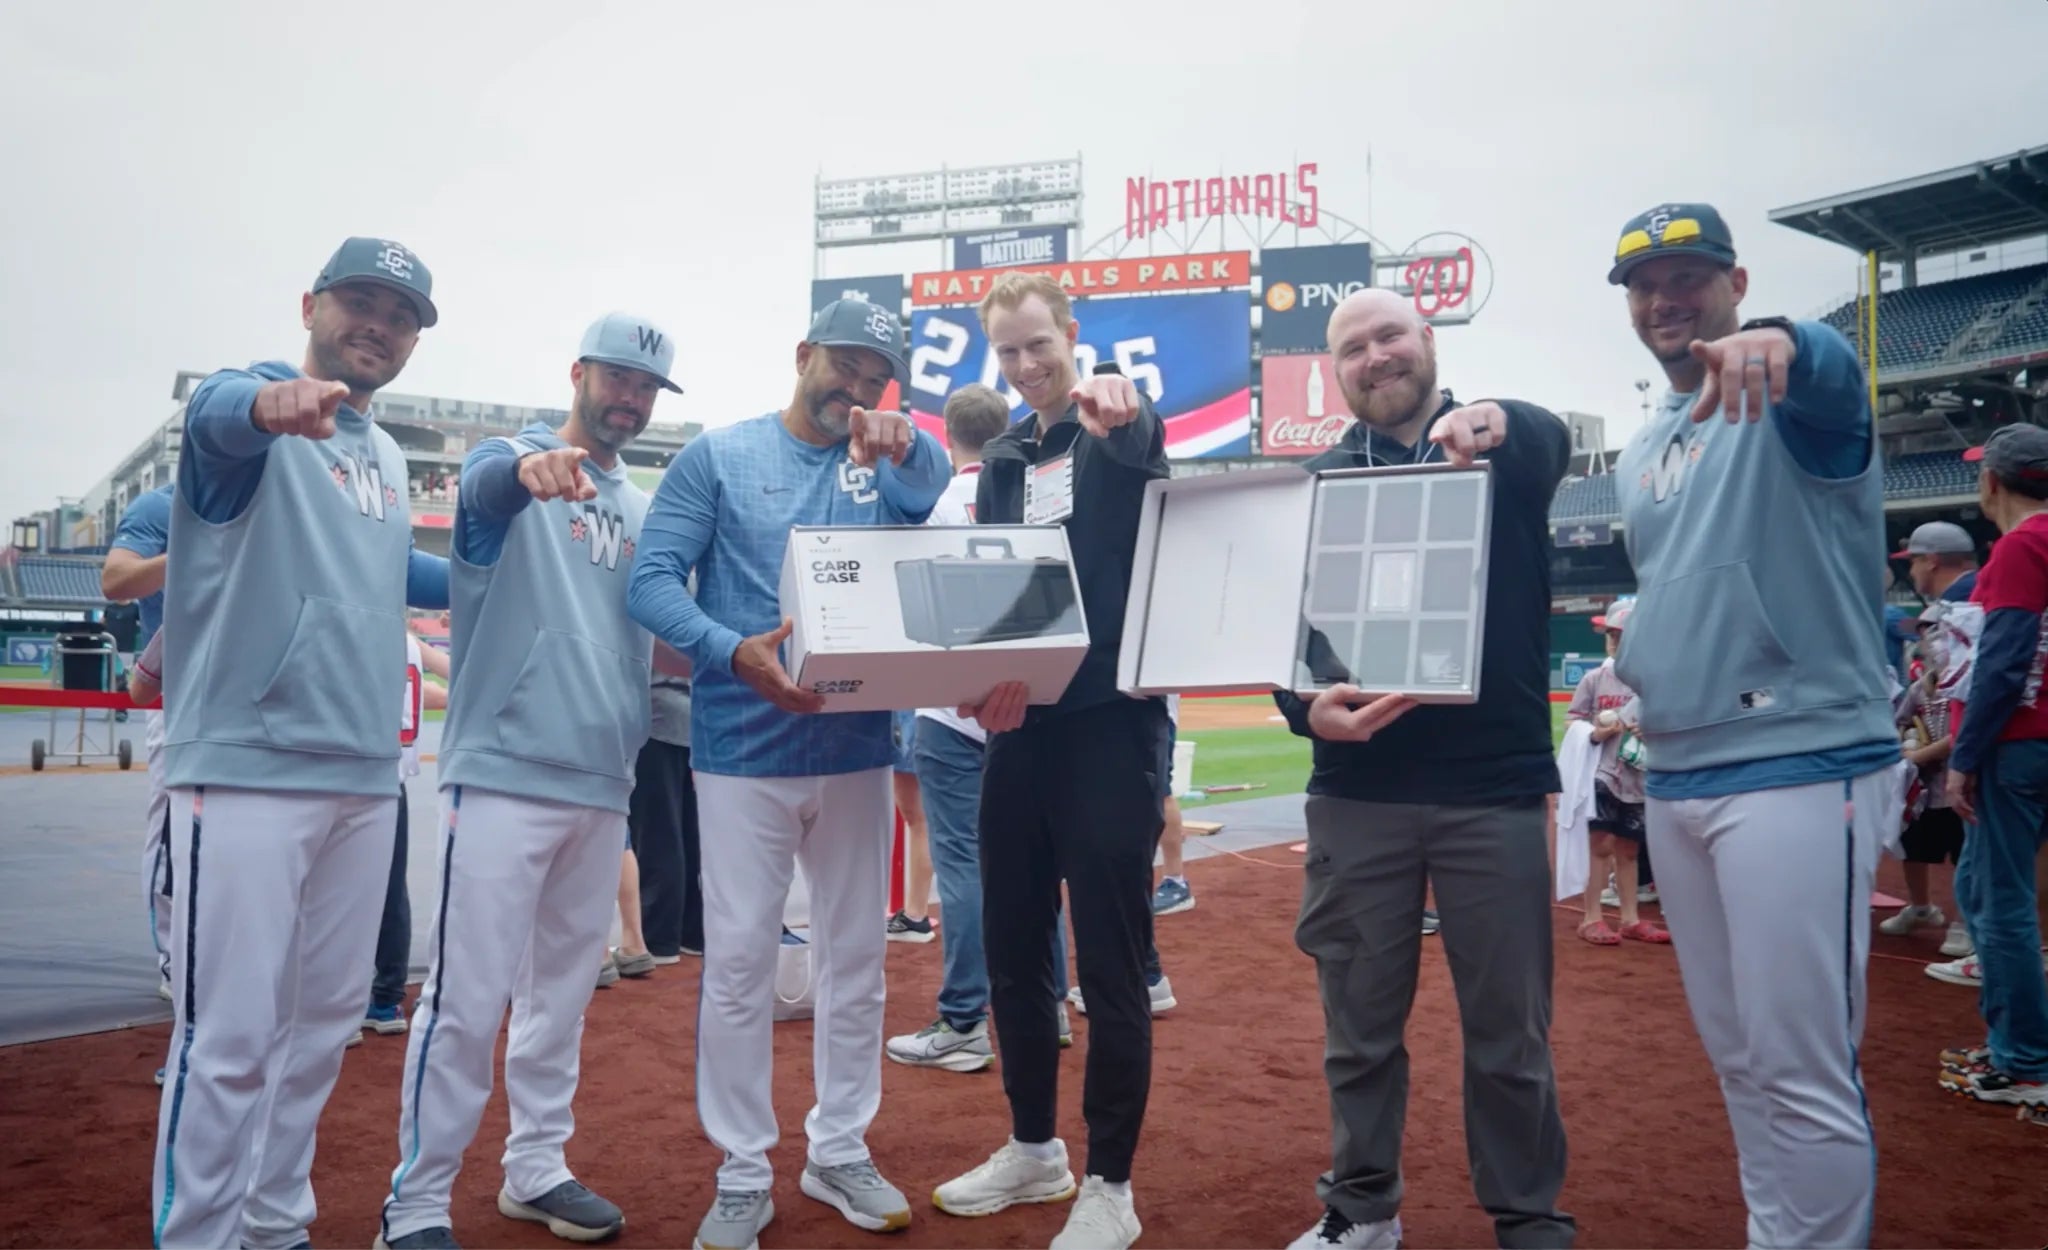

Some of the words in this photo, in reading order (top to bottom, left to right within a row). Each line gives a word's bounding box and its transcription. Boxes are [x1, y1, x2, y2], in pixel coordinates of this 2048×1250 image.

[1126, 163, 1318, 240] NATIONALS
[981, 235, 1054, 264] NATITUDE
[1138, 259, 1230, 283] PARK
[1404, 246, 1474, 317] W
[638, 325, 662, 356] W
[340, 448, 385, 523] W
[584, 504, 624, 572] W
[812, 560, 861, 572] CARD
[814, 572, 860, 583] CASE
